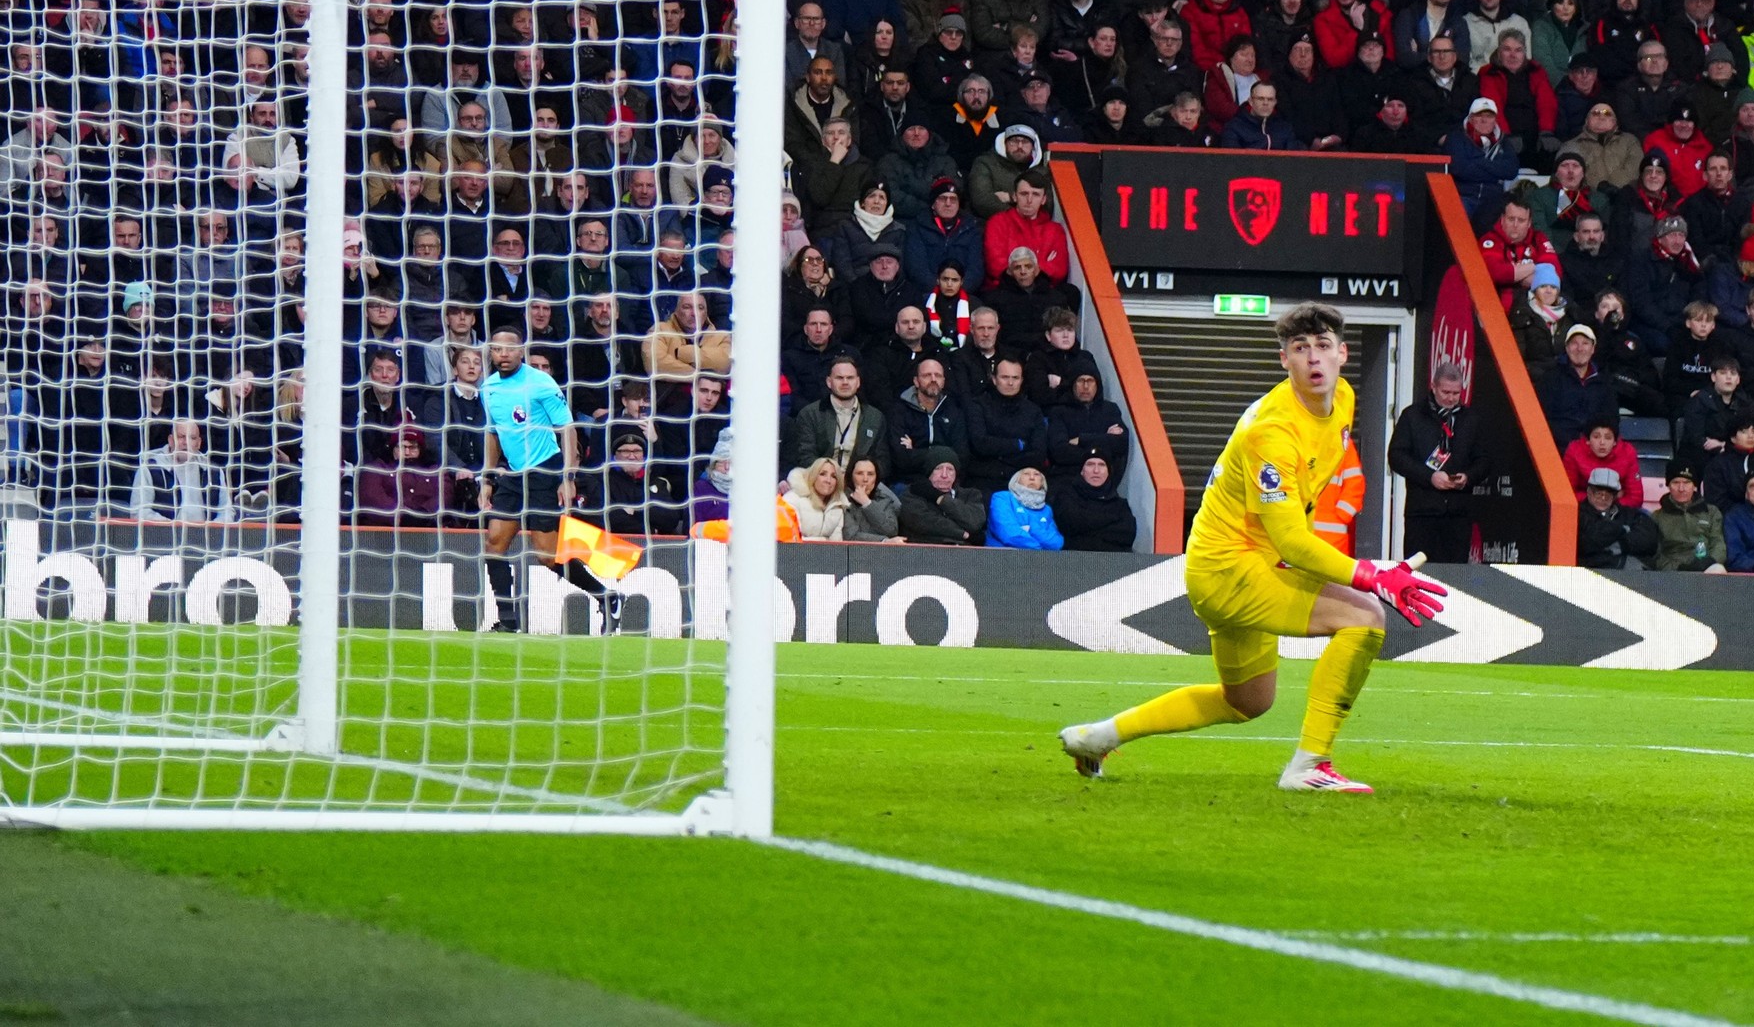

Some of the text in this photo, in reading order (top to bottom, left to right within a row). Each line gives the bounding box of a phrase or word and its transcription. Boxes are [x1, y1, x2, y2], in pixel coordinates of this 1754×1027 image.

[1117, 185, 1392, 237] THE NET
[1113, 270, 1149, 289] V1
[1348, 278, 1399, 297] WV1
